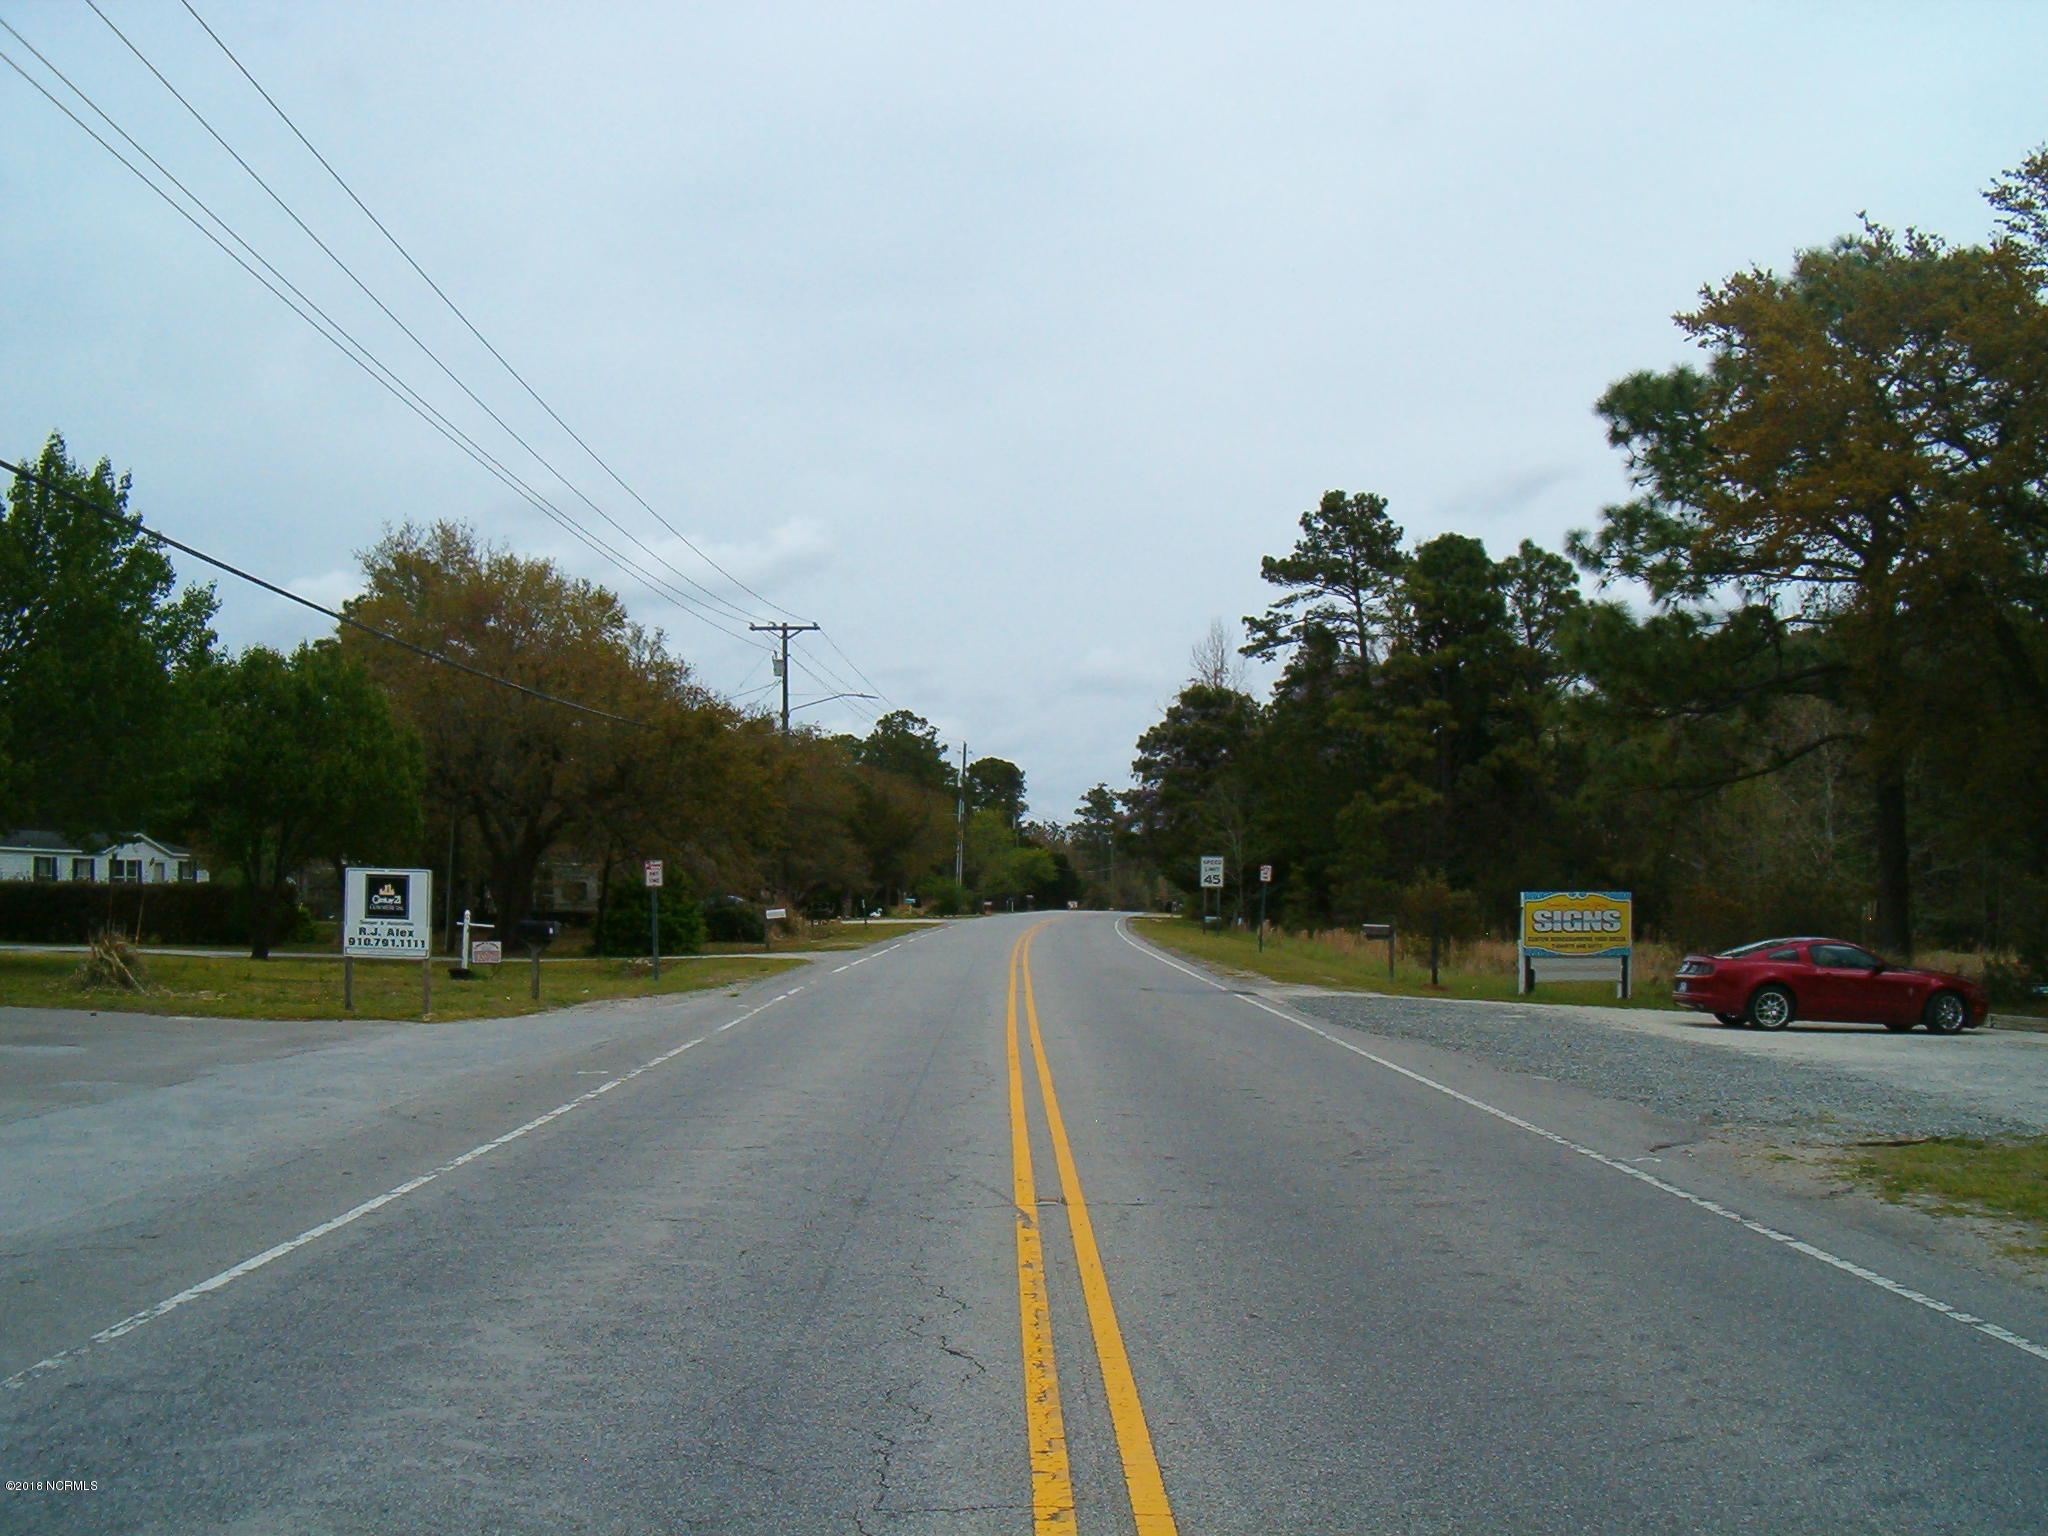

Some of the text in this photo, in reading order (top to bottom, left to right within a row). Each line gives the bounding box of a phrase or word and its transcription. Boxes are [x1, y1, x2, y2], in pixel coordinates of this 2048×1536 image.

[1204, 875, 1221, 884] 45
[1533, 909, 1621, 932] SIGNS
[359, 927, 414, 937] R.J. Alex
[348, 937, 426, 948] 910.791.1111
